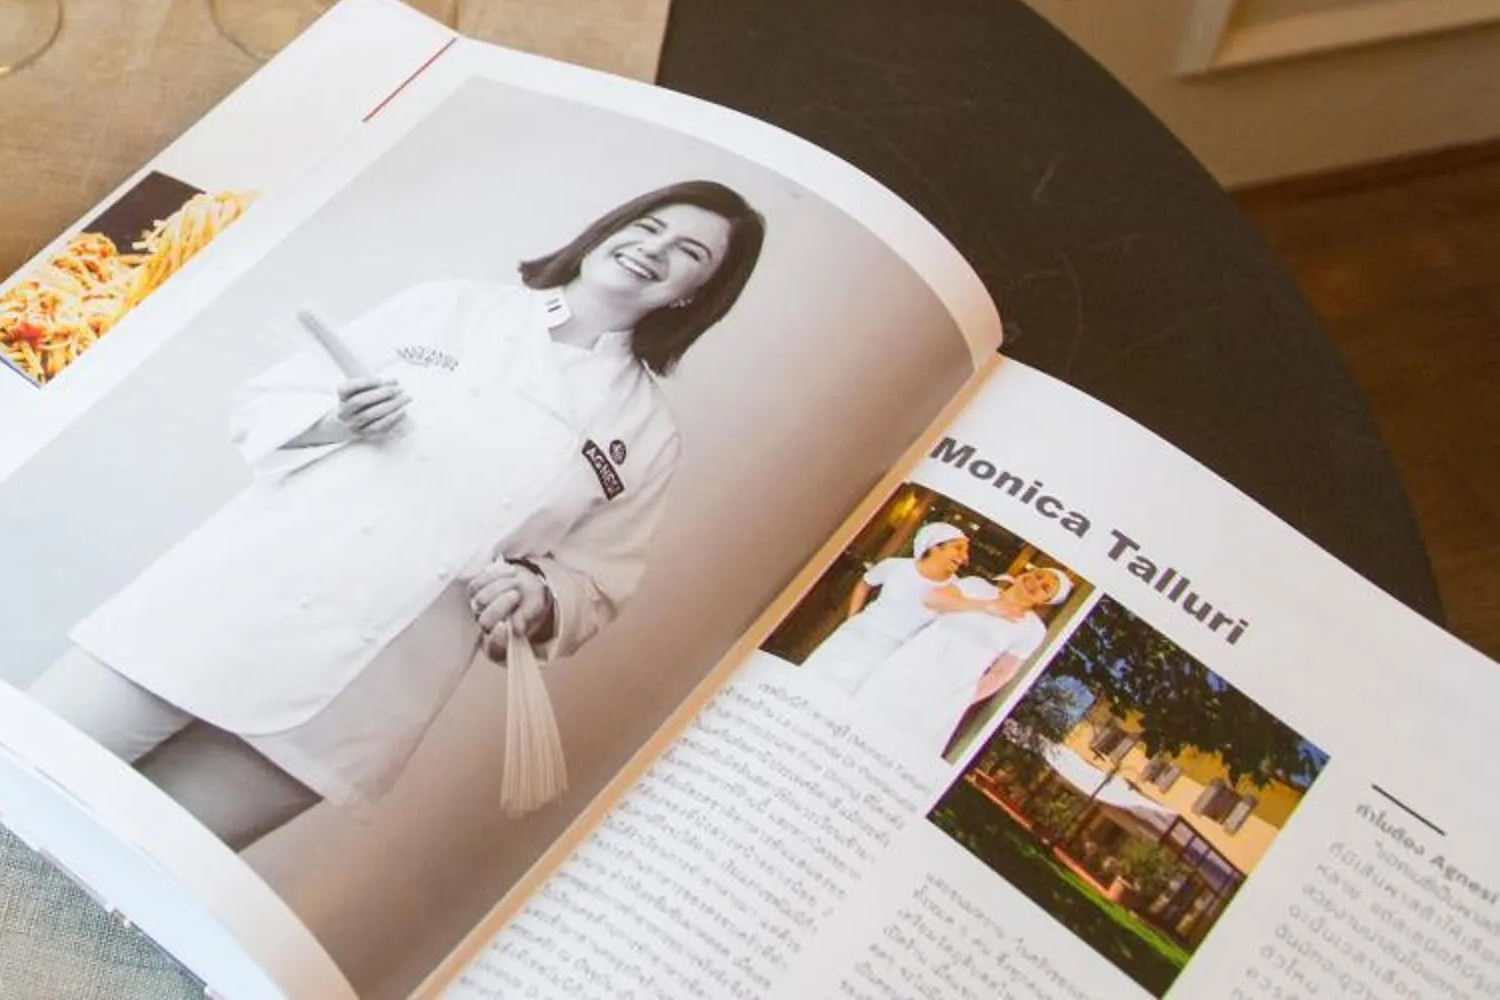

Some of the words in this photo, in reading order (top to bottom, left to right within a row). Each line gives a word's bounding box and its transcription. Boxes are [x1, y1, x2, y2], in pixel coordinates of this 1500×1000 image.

[929, 436, 1092, 538] Monica
[1106, 528, 1250, 646] Talluri
[1429, 854, 1498, 905] Agnesi
